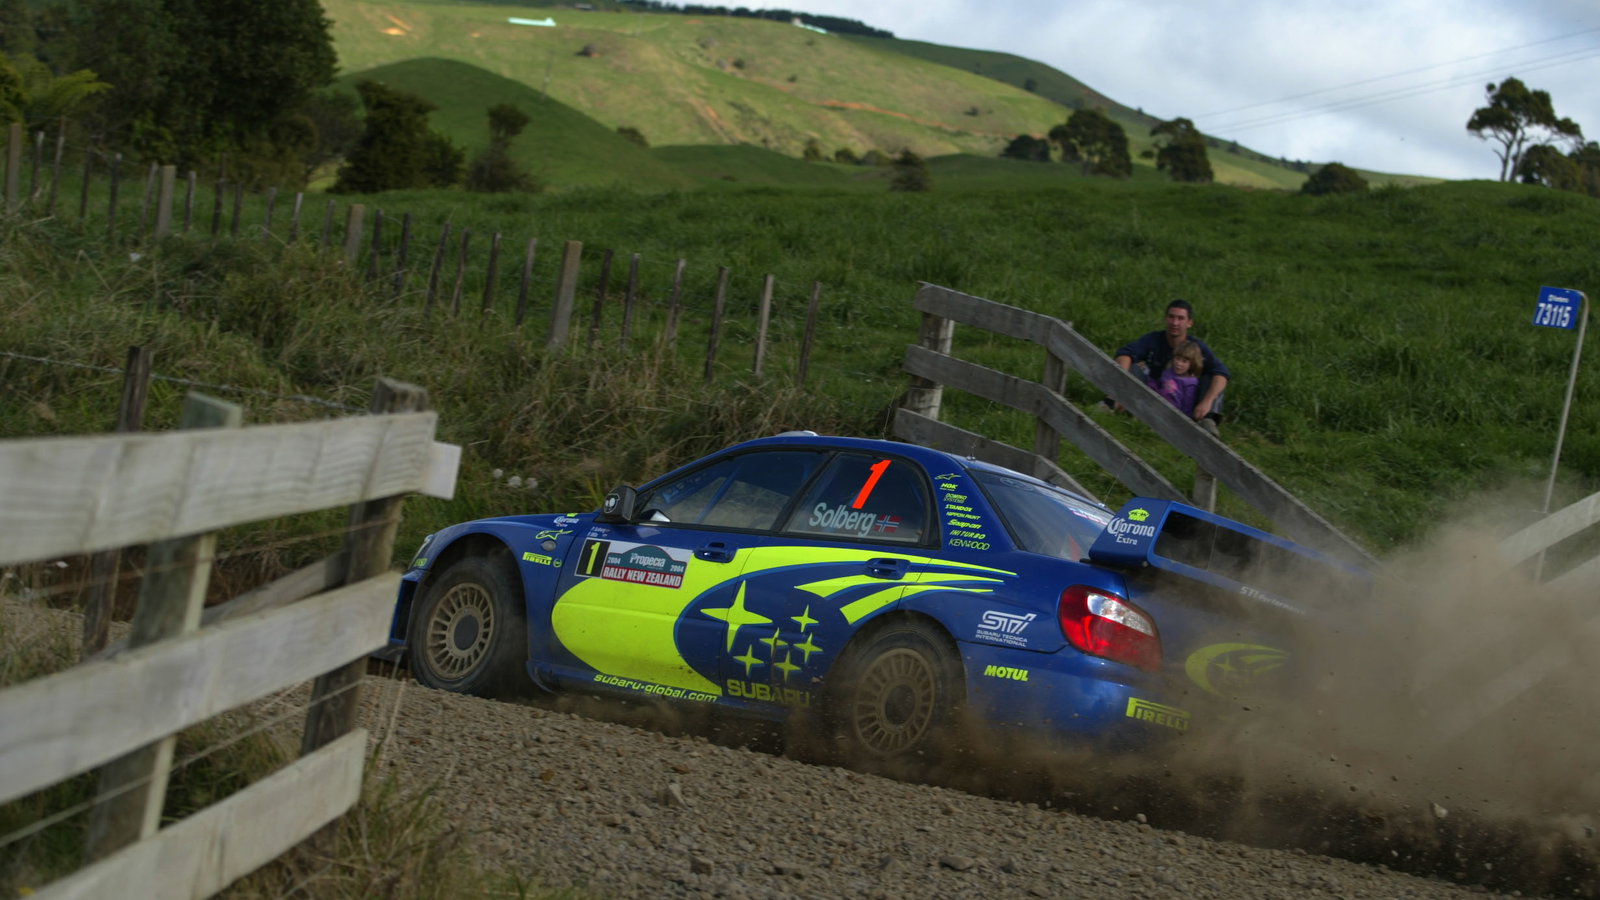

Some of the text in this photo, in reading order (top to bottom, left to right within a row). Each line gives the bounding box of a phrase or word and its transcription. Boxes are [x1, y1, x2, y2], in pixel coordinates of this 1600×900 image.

[1535, 303, 1572, 327] 73115
[852, 460, 892, 509] 1
[809, 502, 877, 537] Solberg
[1107, 517, 1156, 537] Corona
[949, 538, 991, 550] KENWOOD
[1116, 534, 1138, 545] Extra
[586, 541, 600, 574] 1
[629, 552, 666, 567] Propecia
[603, 566, 682, 587] RALLY NEW ZEALAND
[975, 634, 1026, 647] INTERNATIONAL
[984, 665, 1029, 681] MOTUL
[726, 679, 811, 706] SUBARU
[1126, 697, 1191, 731] PIRELLI
